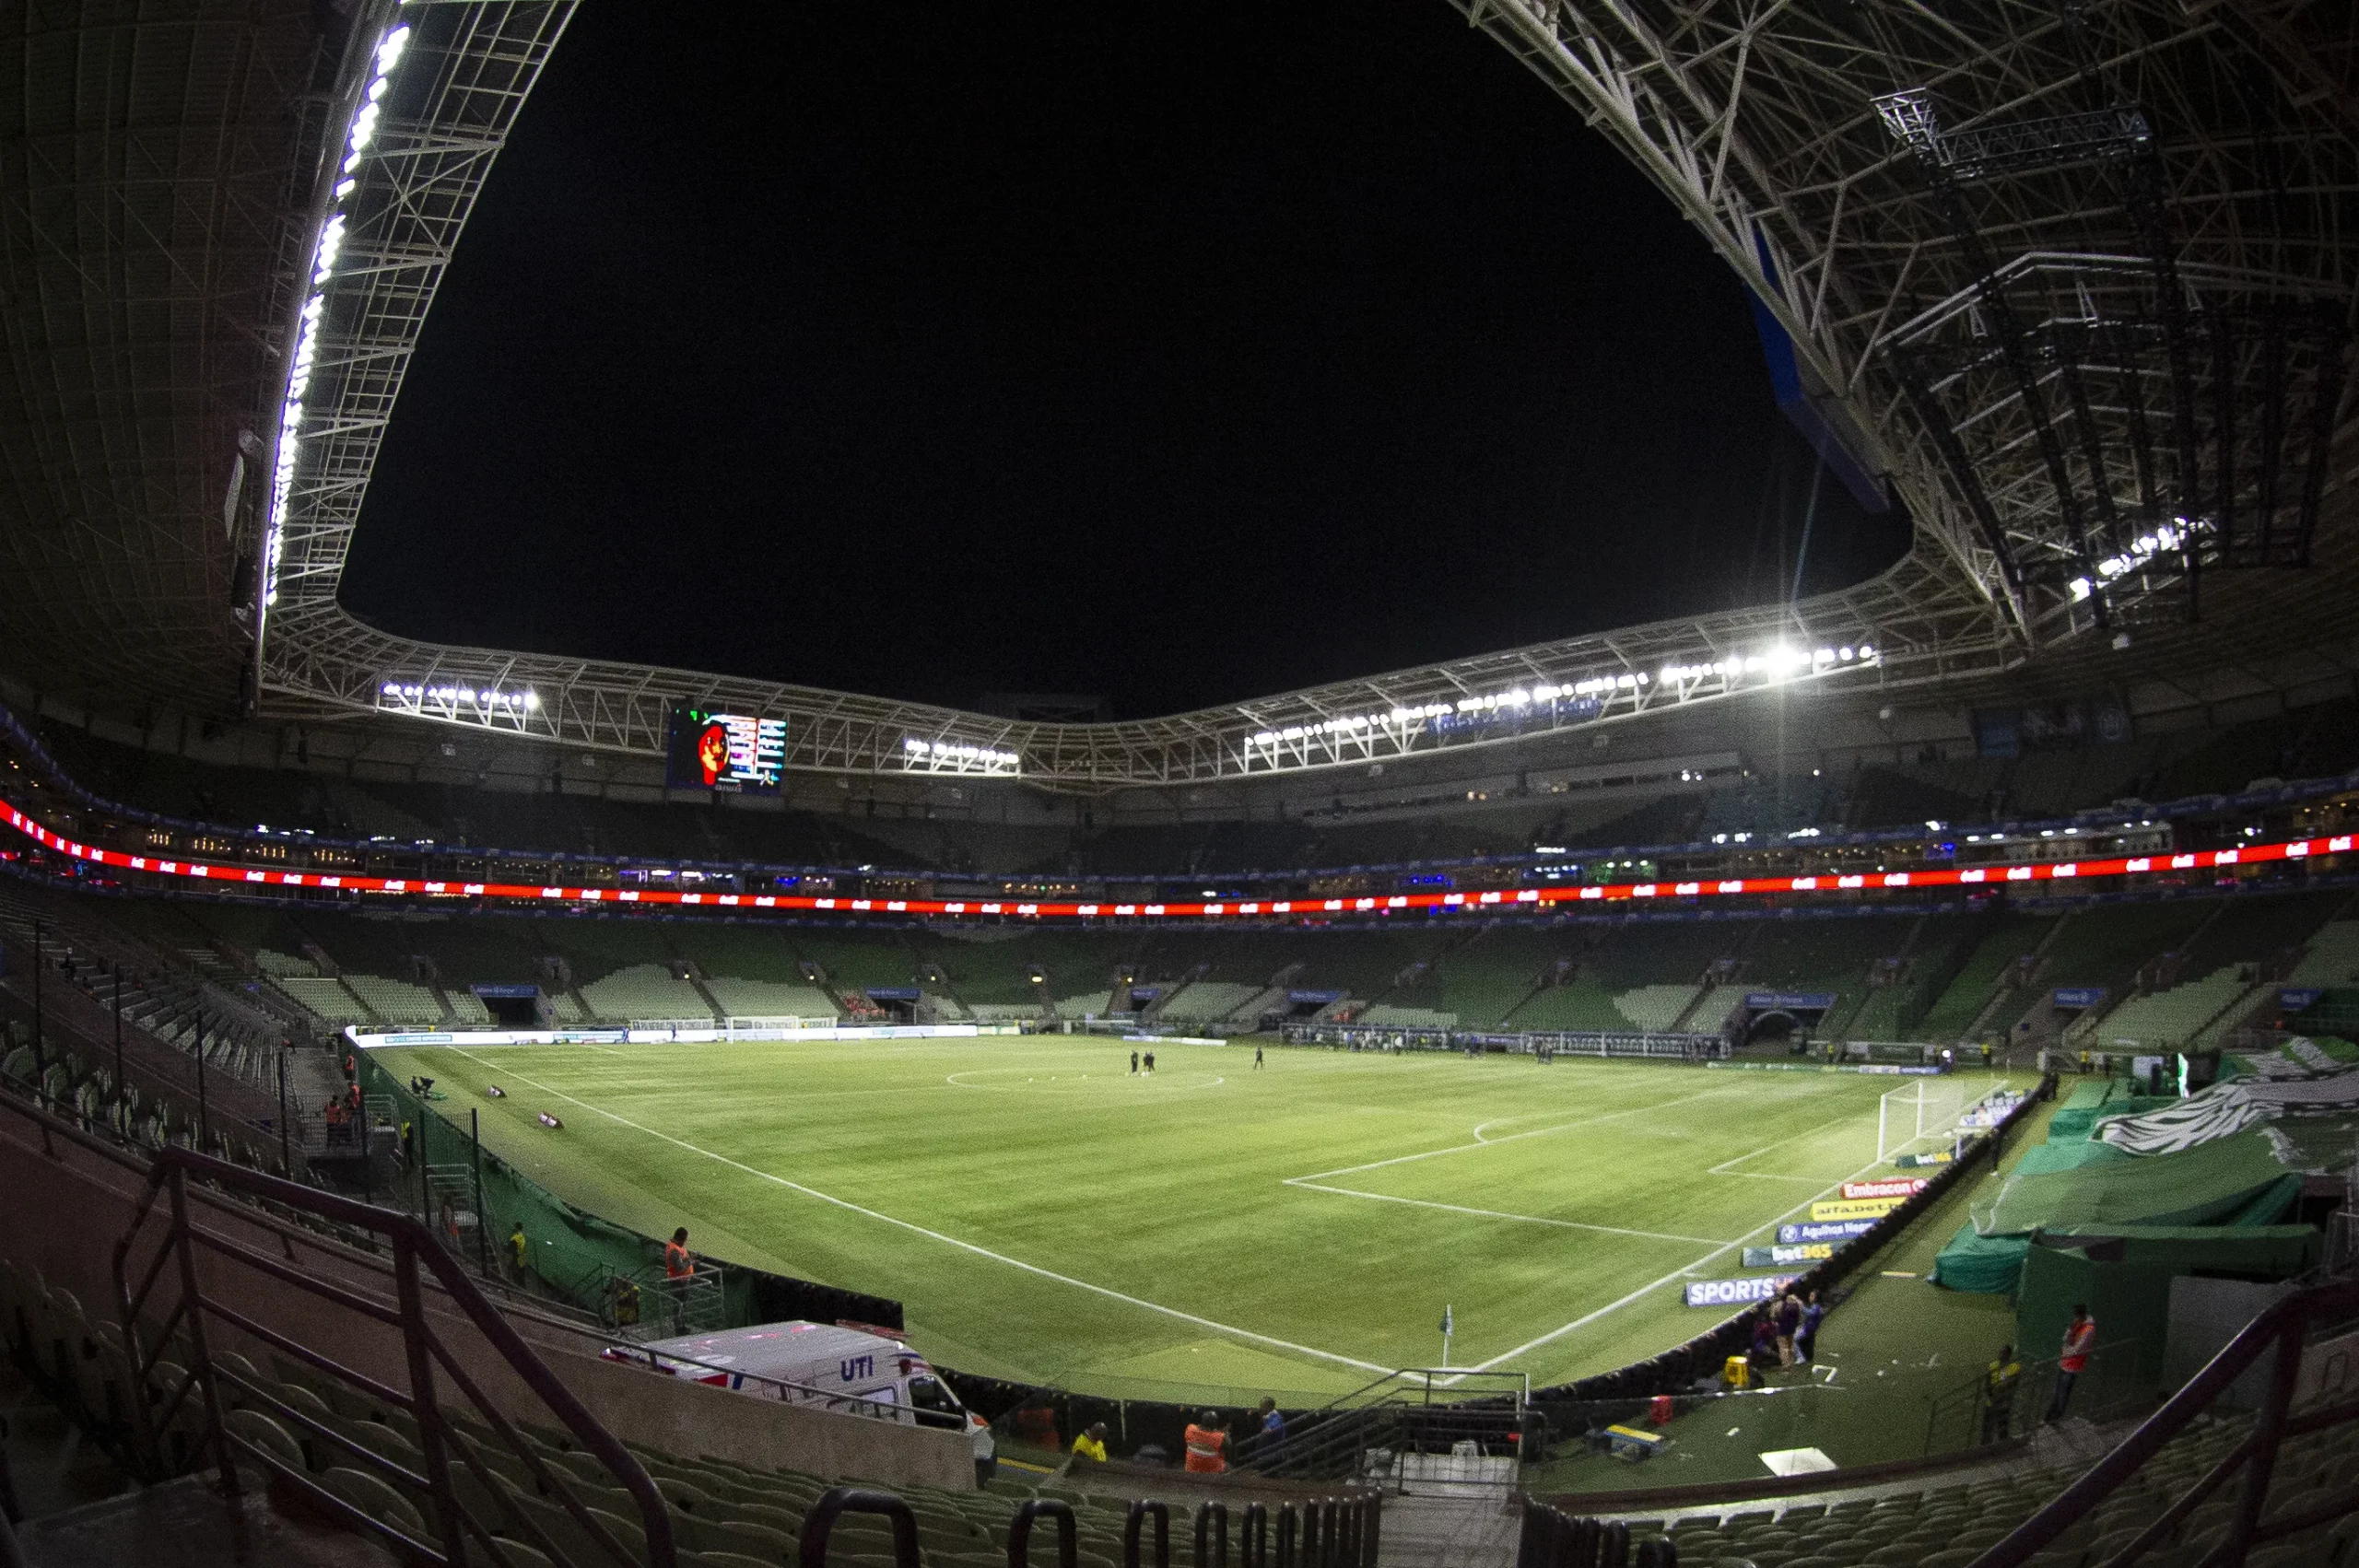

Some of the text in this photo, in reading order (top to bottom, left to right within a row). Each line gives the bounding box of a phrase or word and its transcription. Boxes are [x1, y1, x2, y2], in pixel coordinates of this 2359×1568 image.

[1915, 1153, 1953, 1164] bet365
[1844, 1182, 1912, 1199] Embracon
[1772, 1244, 1832, 1261] bet365
[841, 1355, 874, 1382] UTI
